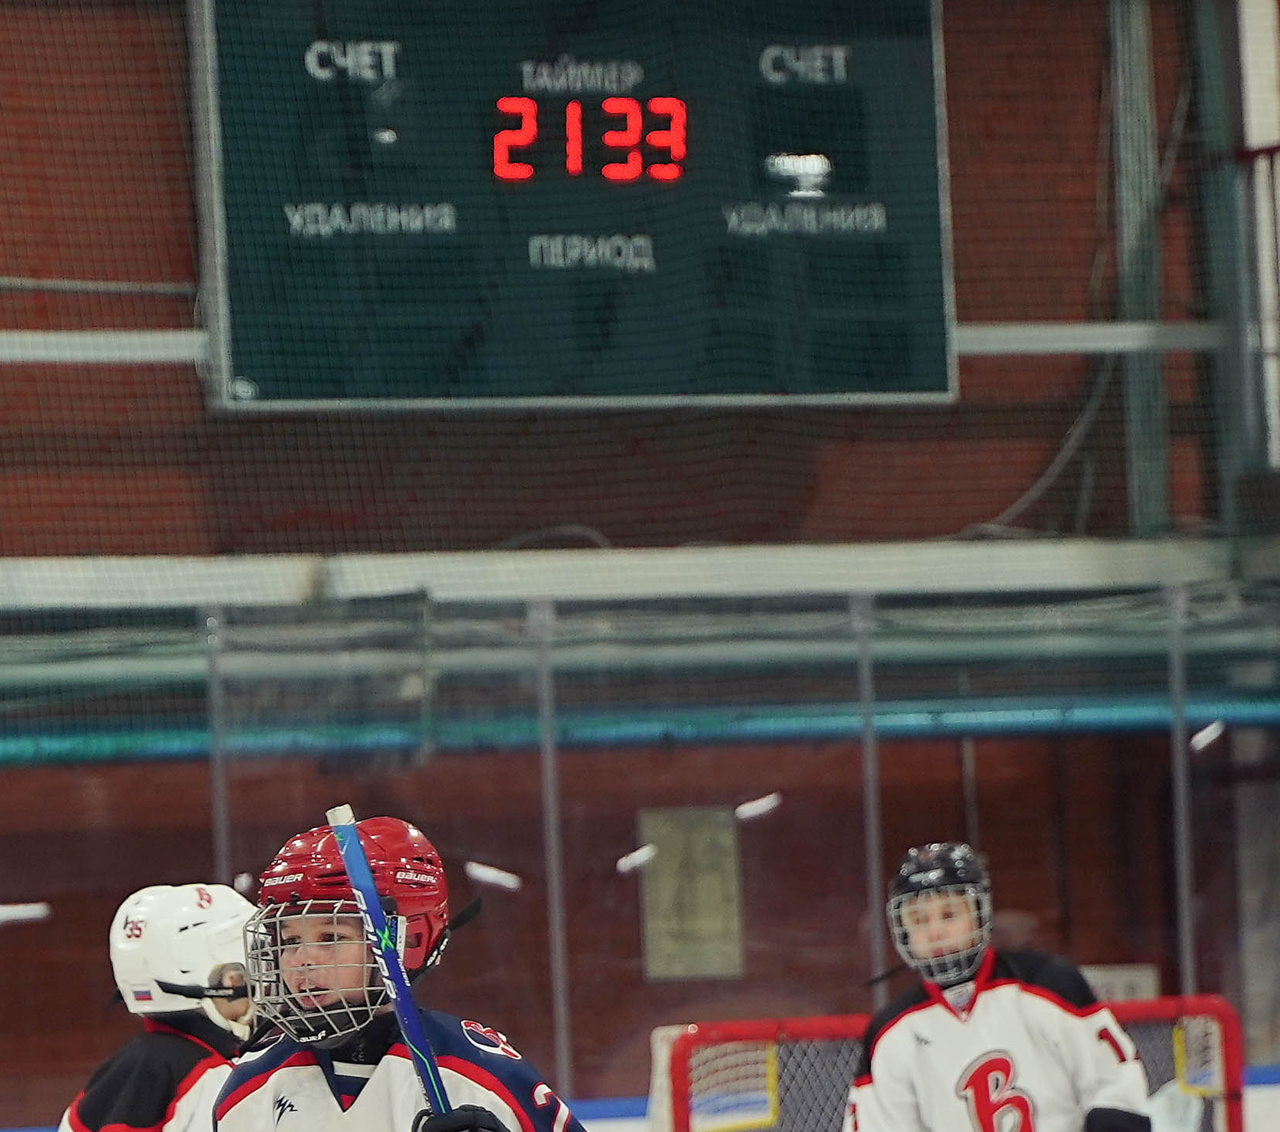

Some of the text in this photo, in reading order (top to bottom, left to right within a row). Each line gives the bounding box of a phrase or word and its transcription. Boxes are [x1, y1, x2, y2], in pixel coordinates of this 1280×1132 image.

[304, 40, 401, 81] СЧЕТ
[522, 55, 644, 92] ТАЙМЕР
[759, 44, 851, 84] СЧЕТ
[284, 202, 457, 237] УДАЛЕНИЯ
[722, 202, 888, 236] УДАЛЕНИЯ
[528, 234, 656, 274] ПЕРИОД
